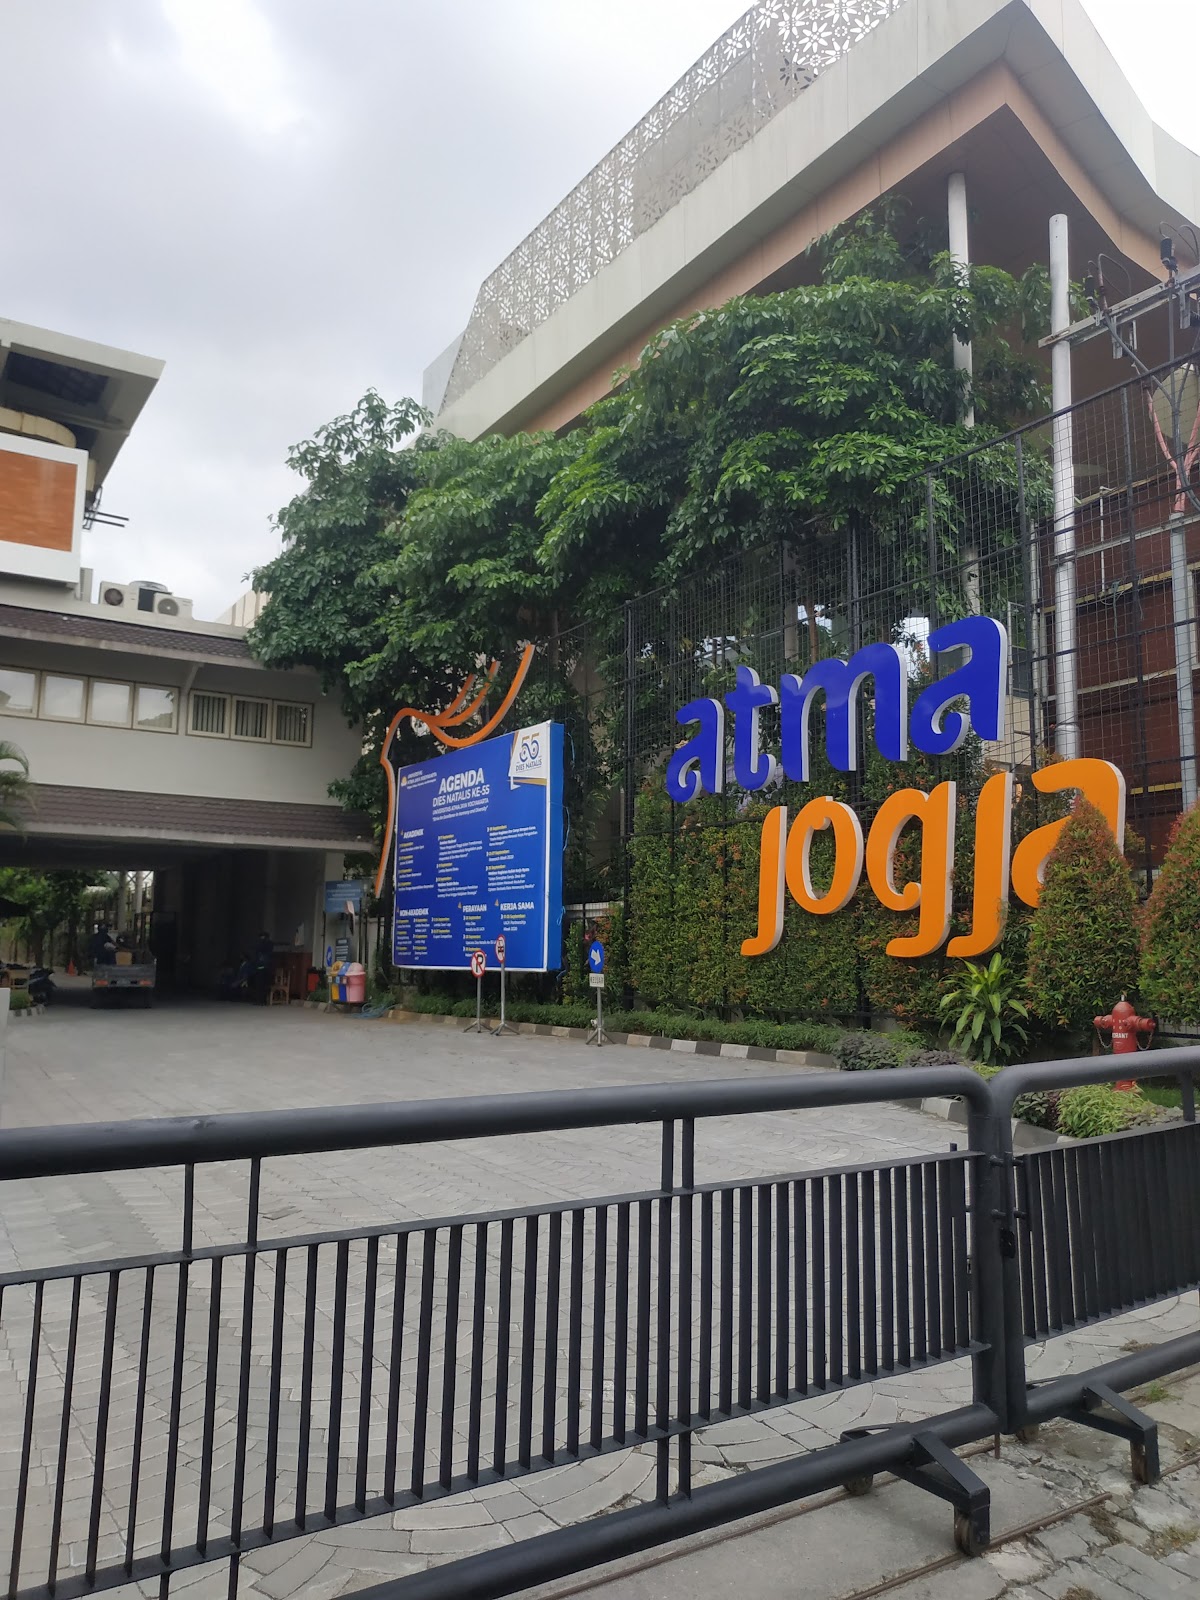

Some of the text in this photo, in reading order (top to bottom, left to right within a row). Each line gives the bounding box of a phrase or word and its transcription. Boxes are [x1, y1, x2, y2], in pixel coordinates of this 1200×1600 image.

[666, 615, 1007, 802] atma
[515, 758, 542, 771] DIES NATALIS
[438, 767, 485, 795] AGENDA
[432, 784, 490, 807] DIES NATALIS KE-55
[740, 757, 1126, 958] jogja
[462, 904, 487, 912] PERAYAAN
[500, 902, 517, 911] KERJA
